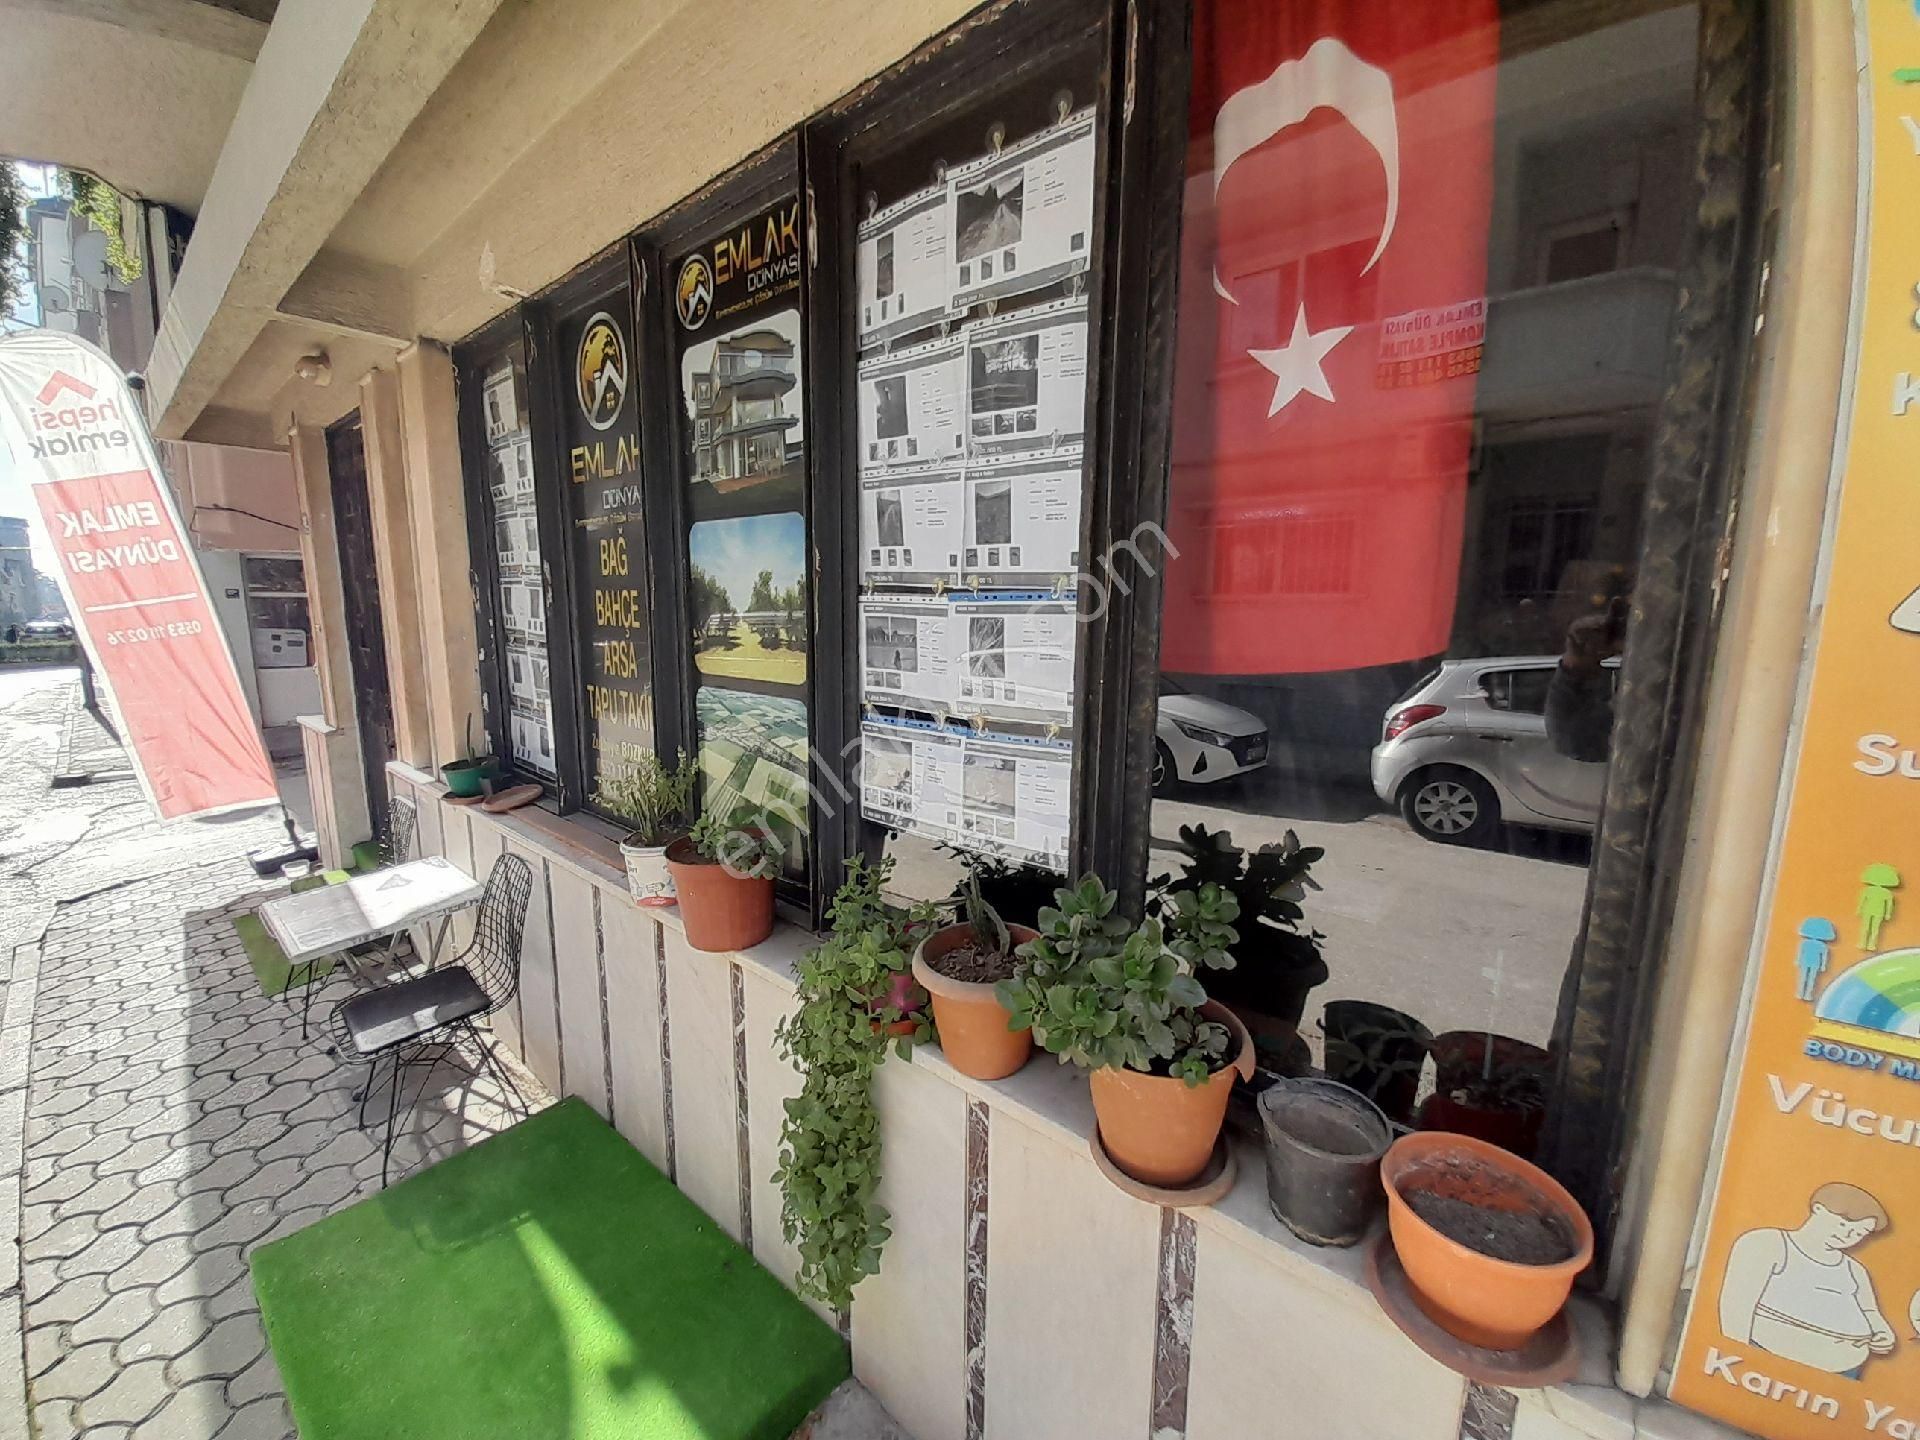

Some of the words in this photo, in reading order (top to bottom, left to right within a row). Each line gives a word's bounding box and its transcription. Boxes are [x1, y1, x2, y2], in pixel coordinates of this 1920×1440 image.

[714, 202, 799, 285] EMLAK
[600, 527, 628, 576] BAĞ
[595, 589, 641, 638] BAHÇE
[603, 640, 638, 678] ARSA
[587, 685, 618, 724] TAPU
[1804, 1040, 1884, 1071] BODY
[1766, 1073, 1920, 1148] Vücu
[1704, 1347, 1840, 1420] Karın
